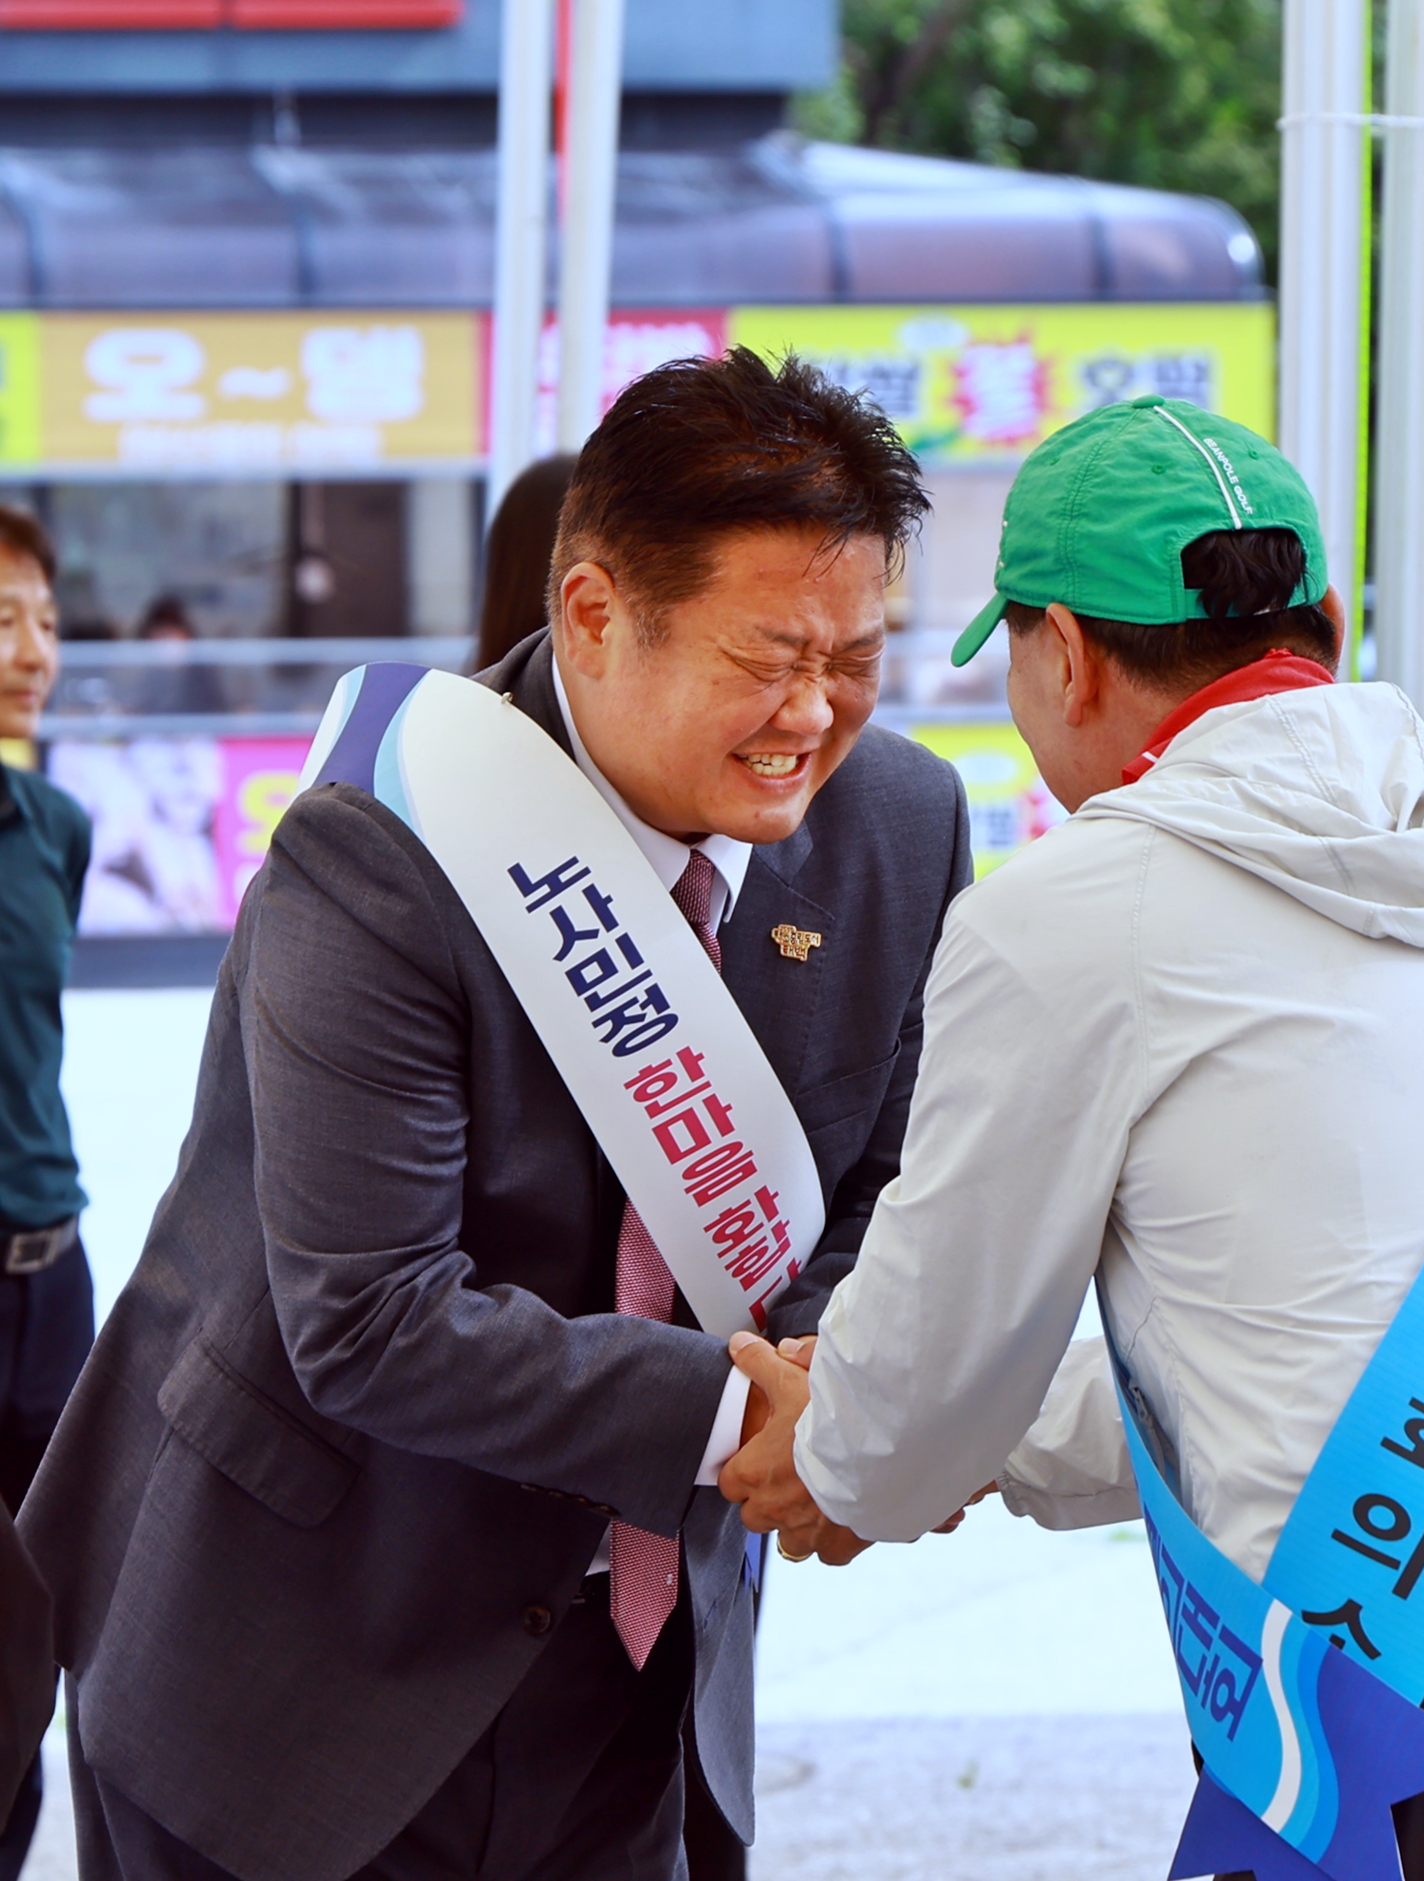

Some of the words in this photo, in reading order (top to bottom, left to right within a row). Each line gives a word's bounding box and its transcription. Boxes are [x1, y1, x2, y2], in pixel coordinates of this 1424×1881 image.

[1203, 437, 1239, 485] BEANPOLE
[1233, 485, 1254, 515] GOLF
[507, 855, 679, 1058] 노사민정
[623, 1045, 759, 1208] 한마음
[703, 1185, 792, 1292] 화합
